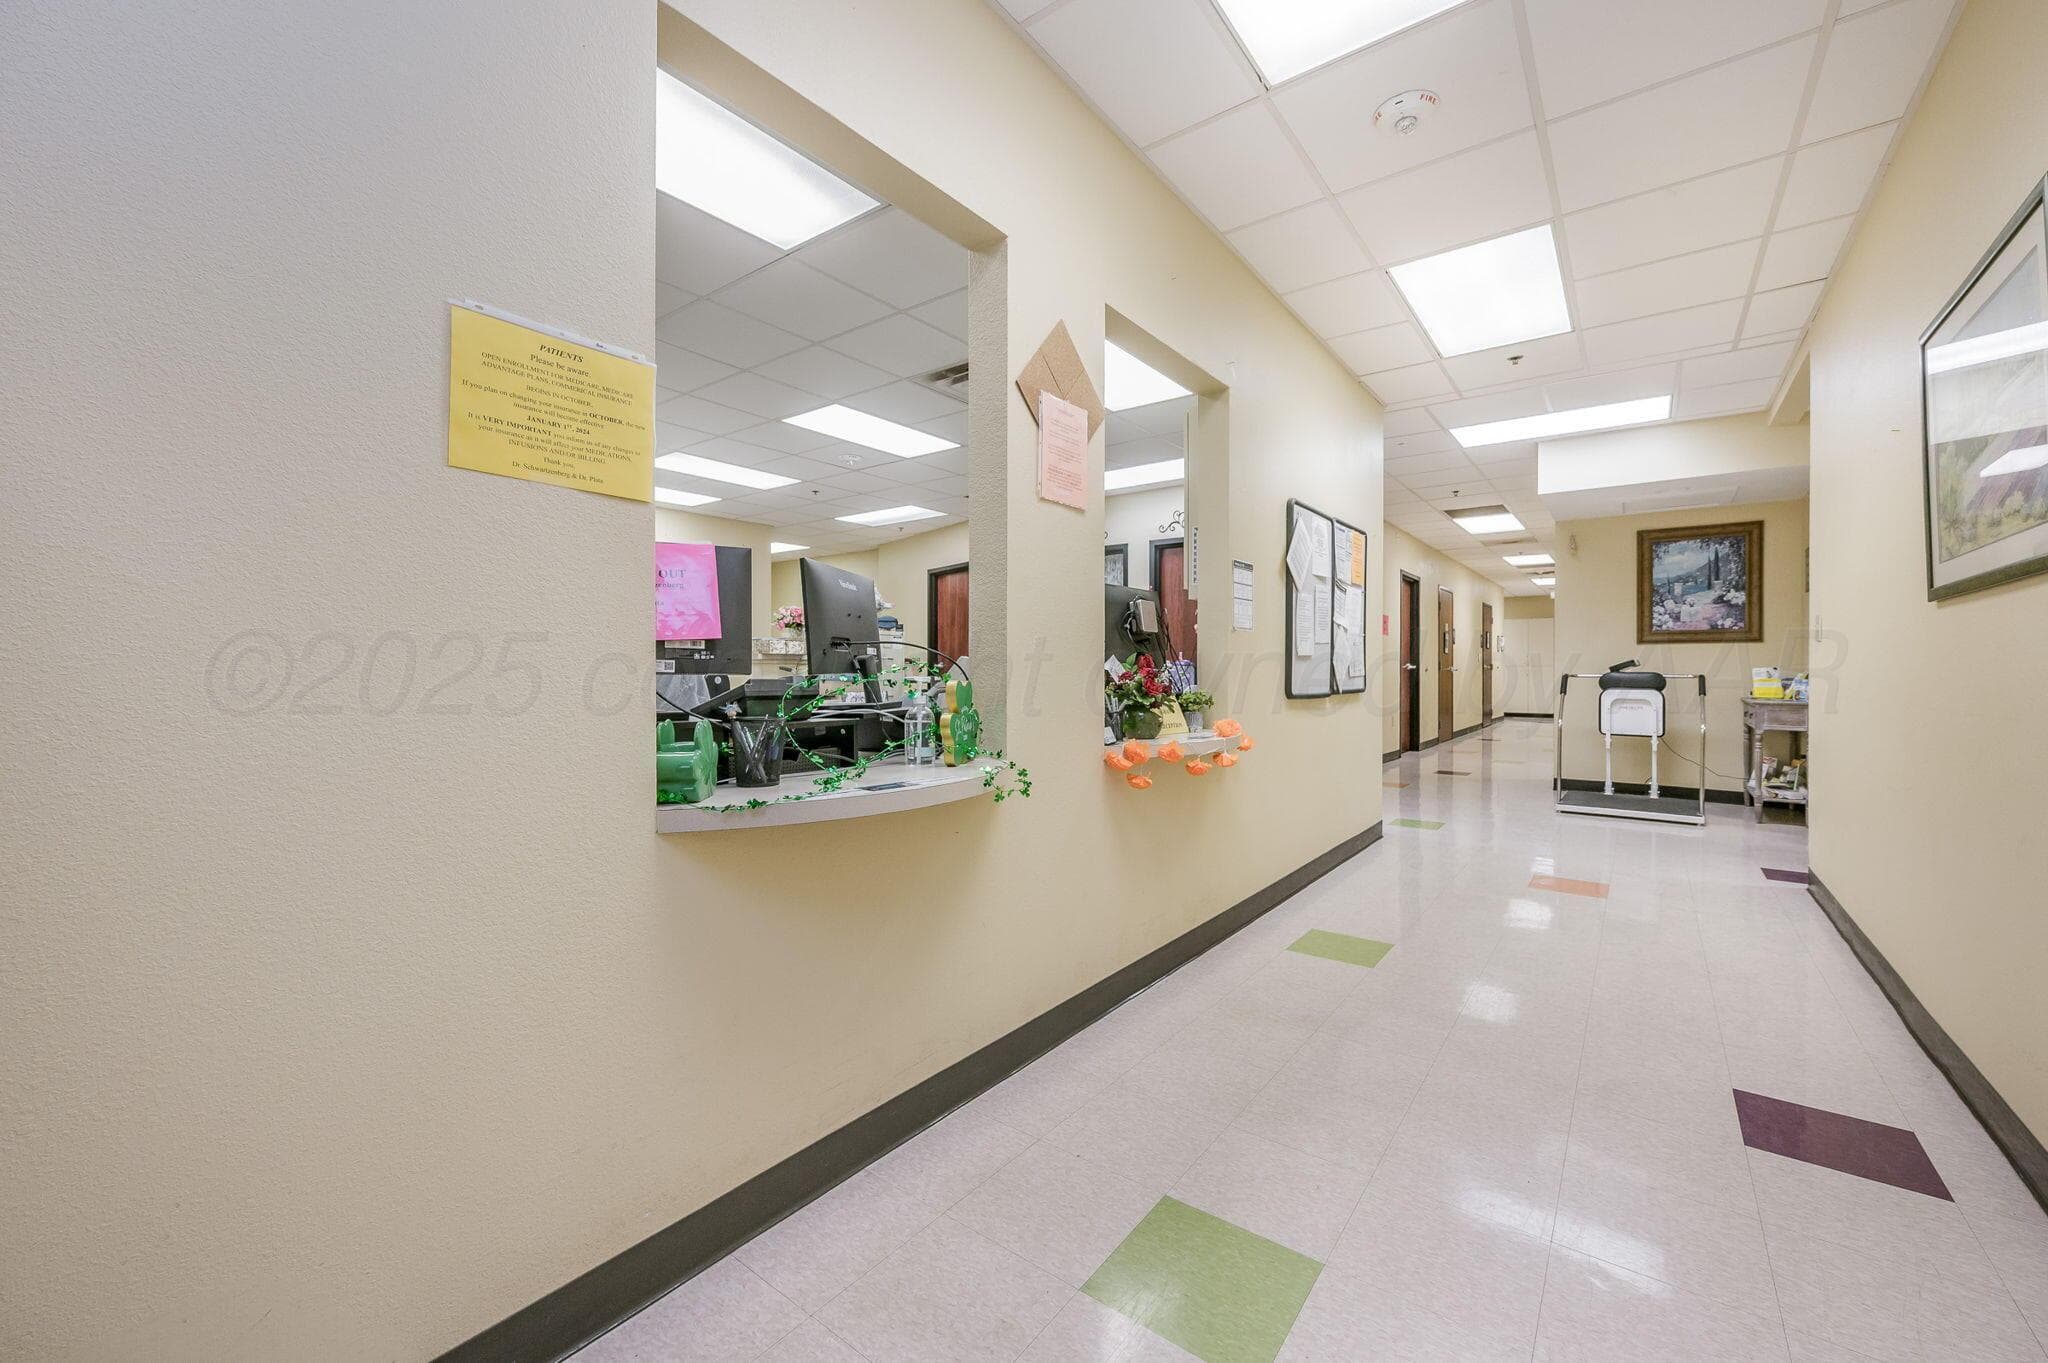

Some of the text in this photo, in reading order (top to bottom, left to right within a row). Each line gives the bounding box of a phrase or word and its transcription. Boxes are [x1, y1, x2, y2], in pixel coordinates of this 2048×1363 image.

[1419, 93, 1438, 106] FIRE
[529, 353, 553, 367] Please
[555, 361, 565, 370] be
[539, 343, 583, 363] PATIENTS
[481, 351, 501, 362] OPEN
[501, 357, 549, 376] ENROLLMENT
[549, 370, 564, 380] FOR
[601, 385, 633, 399] MEDICARE
[481, 359, 525, 377] ADVANTAGE
[596, 391, 632, 406] INSURANCE
[468, 382, 482, 391] you
[483, 384, 498, 394] plan
[508, 390, 537, 405] changing
[537, 400, 552, 408] your
[553, 403, 582, 415] insurance
[525, 384, 552, 396] BEGINS
[512, 401, 543, 414] insurance
[543, 408, 555, 417] will
[555, 411, 578, 423] become
[482, 414, 504, 425] VERY
[505, 419, 551, 436] IMPORTANT
[553, 431, 564, 440] you
[526, 414, 561, 429] JANUARY
[575, 426, 590, 435] 2024
[477, 424, 495, 434] your
[495, 426, 525, 439] insurance
[539, 436, 552, 445] will
[552, 439, 570, 449] affect
[570, 444, 583, 453] your
[508, 438, 547, 452] INFUSIONS
[543, 456, 561, 466] Thank
[658, 569, 687, 579] OUT
